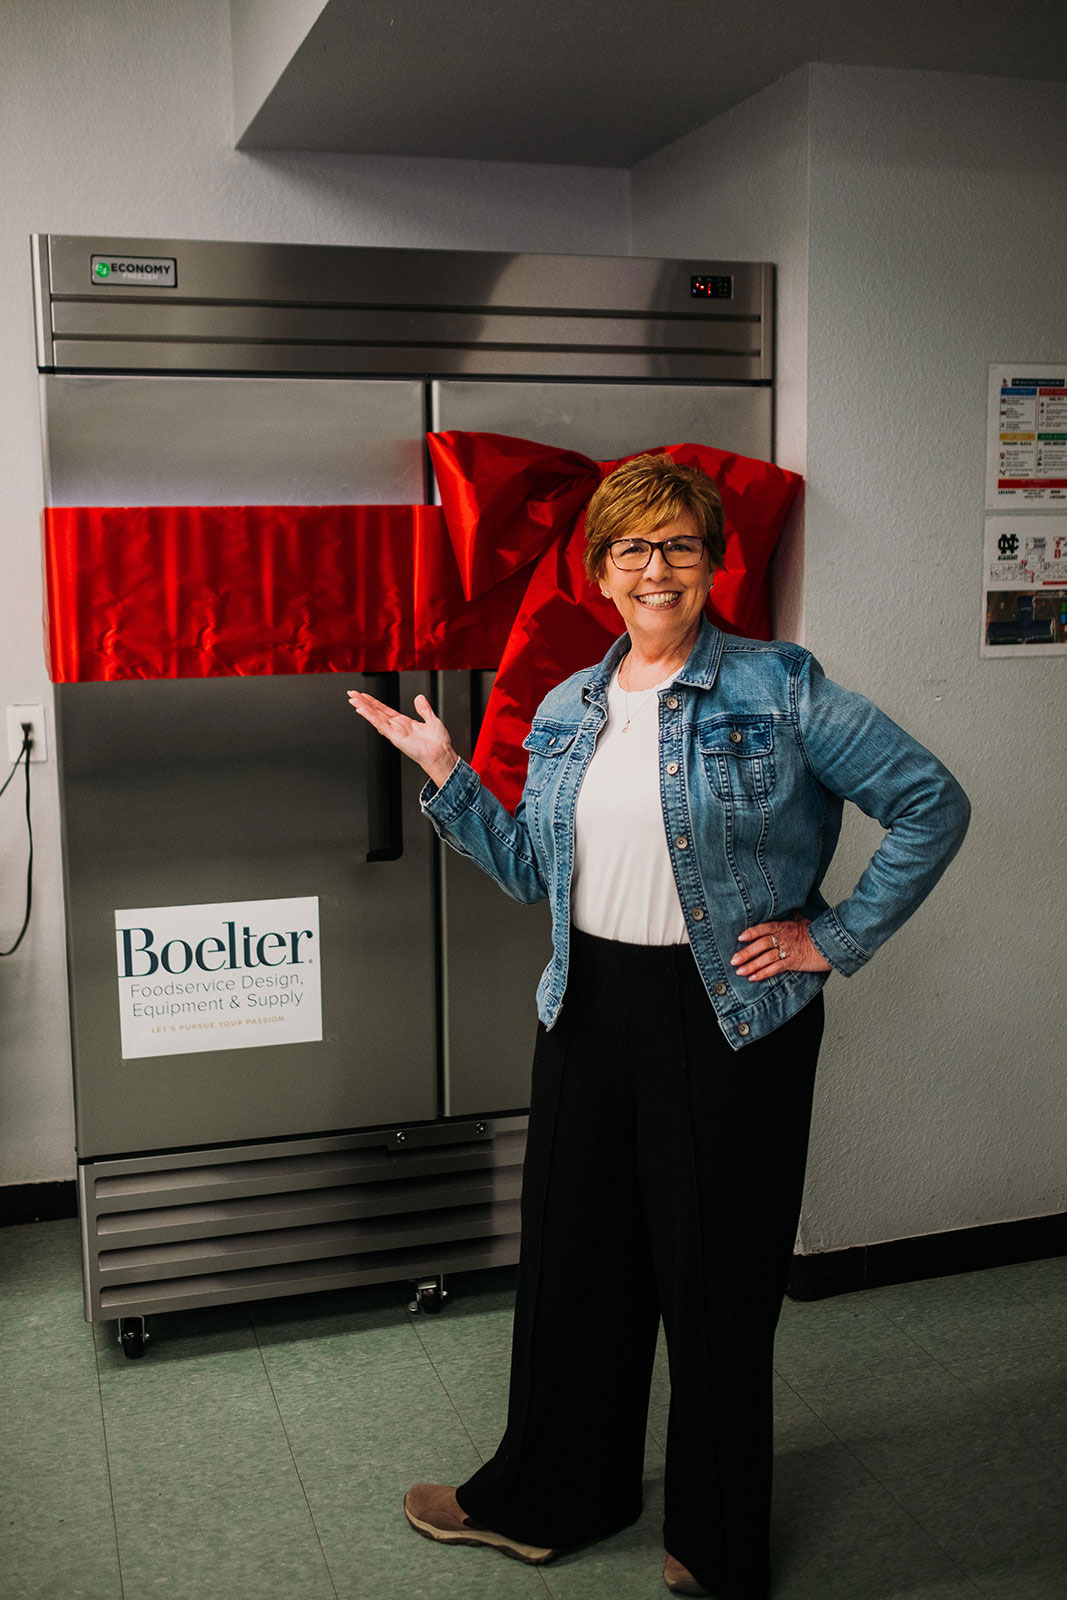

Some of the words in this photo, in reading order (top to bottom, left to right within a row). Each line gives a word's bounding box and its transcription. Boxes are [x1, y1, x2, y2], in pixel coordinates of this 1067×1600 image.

[111, 263, 170, 274] ECONOMY
[130, 978, 236, 998] Foodservice
[241, 973, 304, 990] Design,
[133, 998, 224, 1019] Equipment
[229, 995, 240, 1009] &
[247, 991, 304, 1008] Supply
[151, 1025, 176, 1034] LET'S
[179, 1022, 214, 1032] PURSUE
[218, 1019, 243, 1028] YOUR
